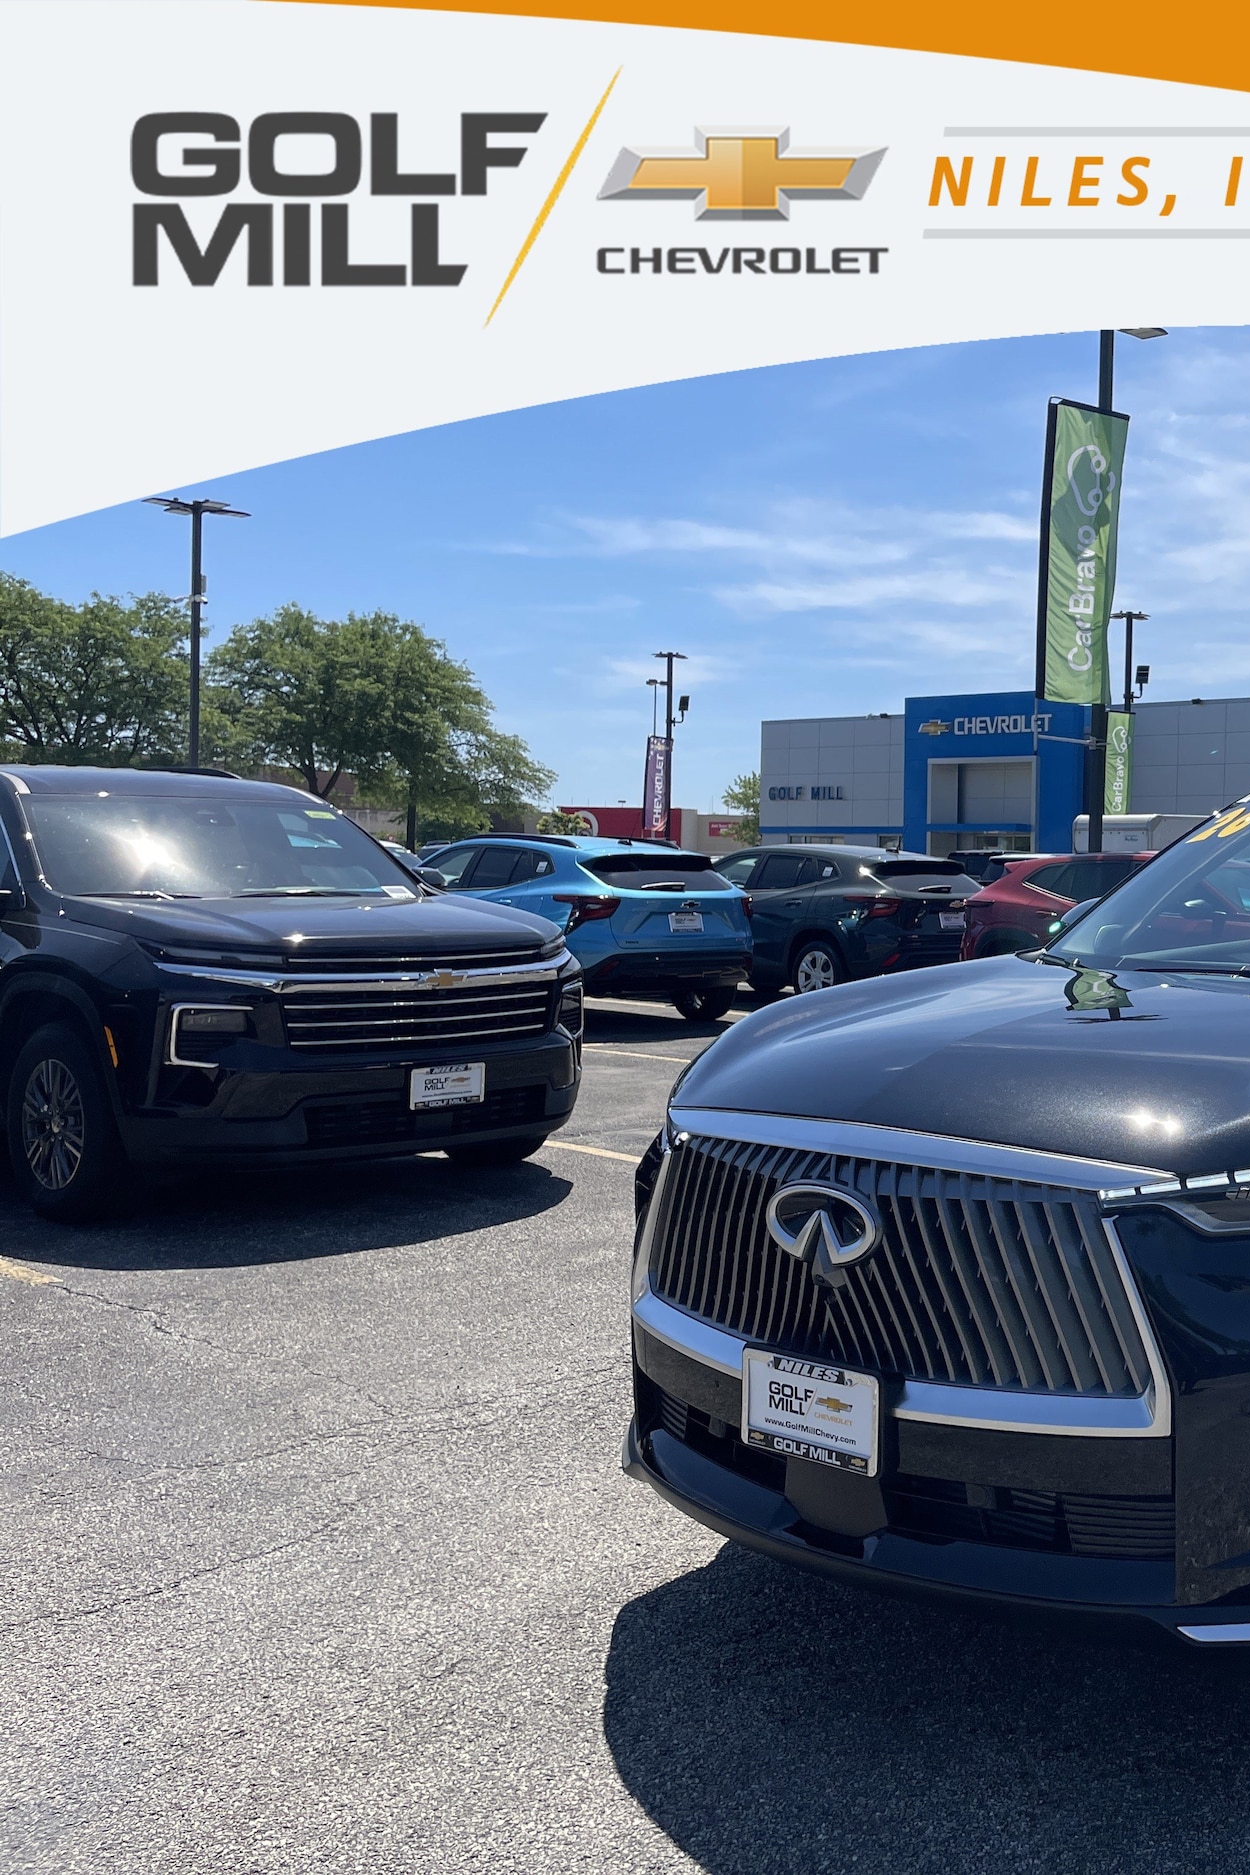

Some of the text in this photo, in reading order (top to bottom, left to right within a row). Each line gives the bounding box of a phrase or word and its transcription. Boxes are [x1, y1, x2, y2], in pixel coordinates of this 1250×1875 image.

[1067, 525, 1096, 672] CarBravo
[954, 713, 1052, 735] CHEVROLET
[652, 753, 665, 826] CHEVROLET
[768, 786, 844, 801] GOLF MILL
[1111, 755, 1125, 812] CarBravo
[424, 1076, 450, 1086] GOLF
[778, 1359, 839, 1383] NILES
[769, 1381, 814, 1402] GOLF
[769, 1395, 806, 1416] MILL
[764, 1416, 857, 1446] www.GolfMillChevy.com
[773, 1436, 807, 1456] GOLF
[809, 1447, 842, 1466] MILL
